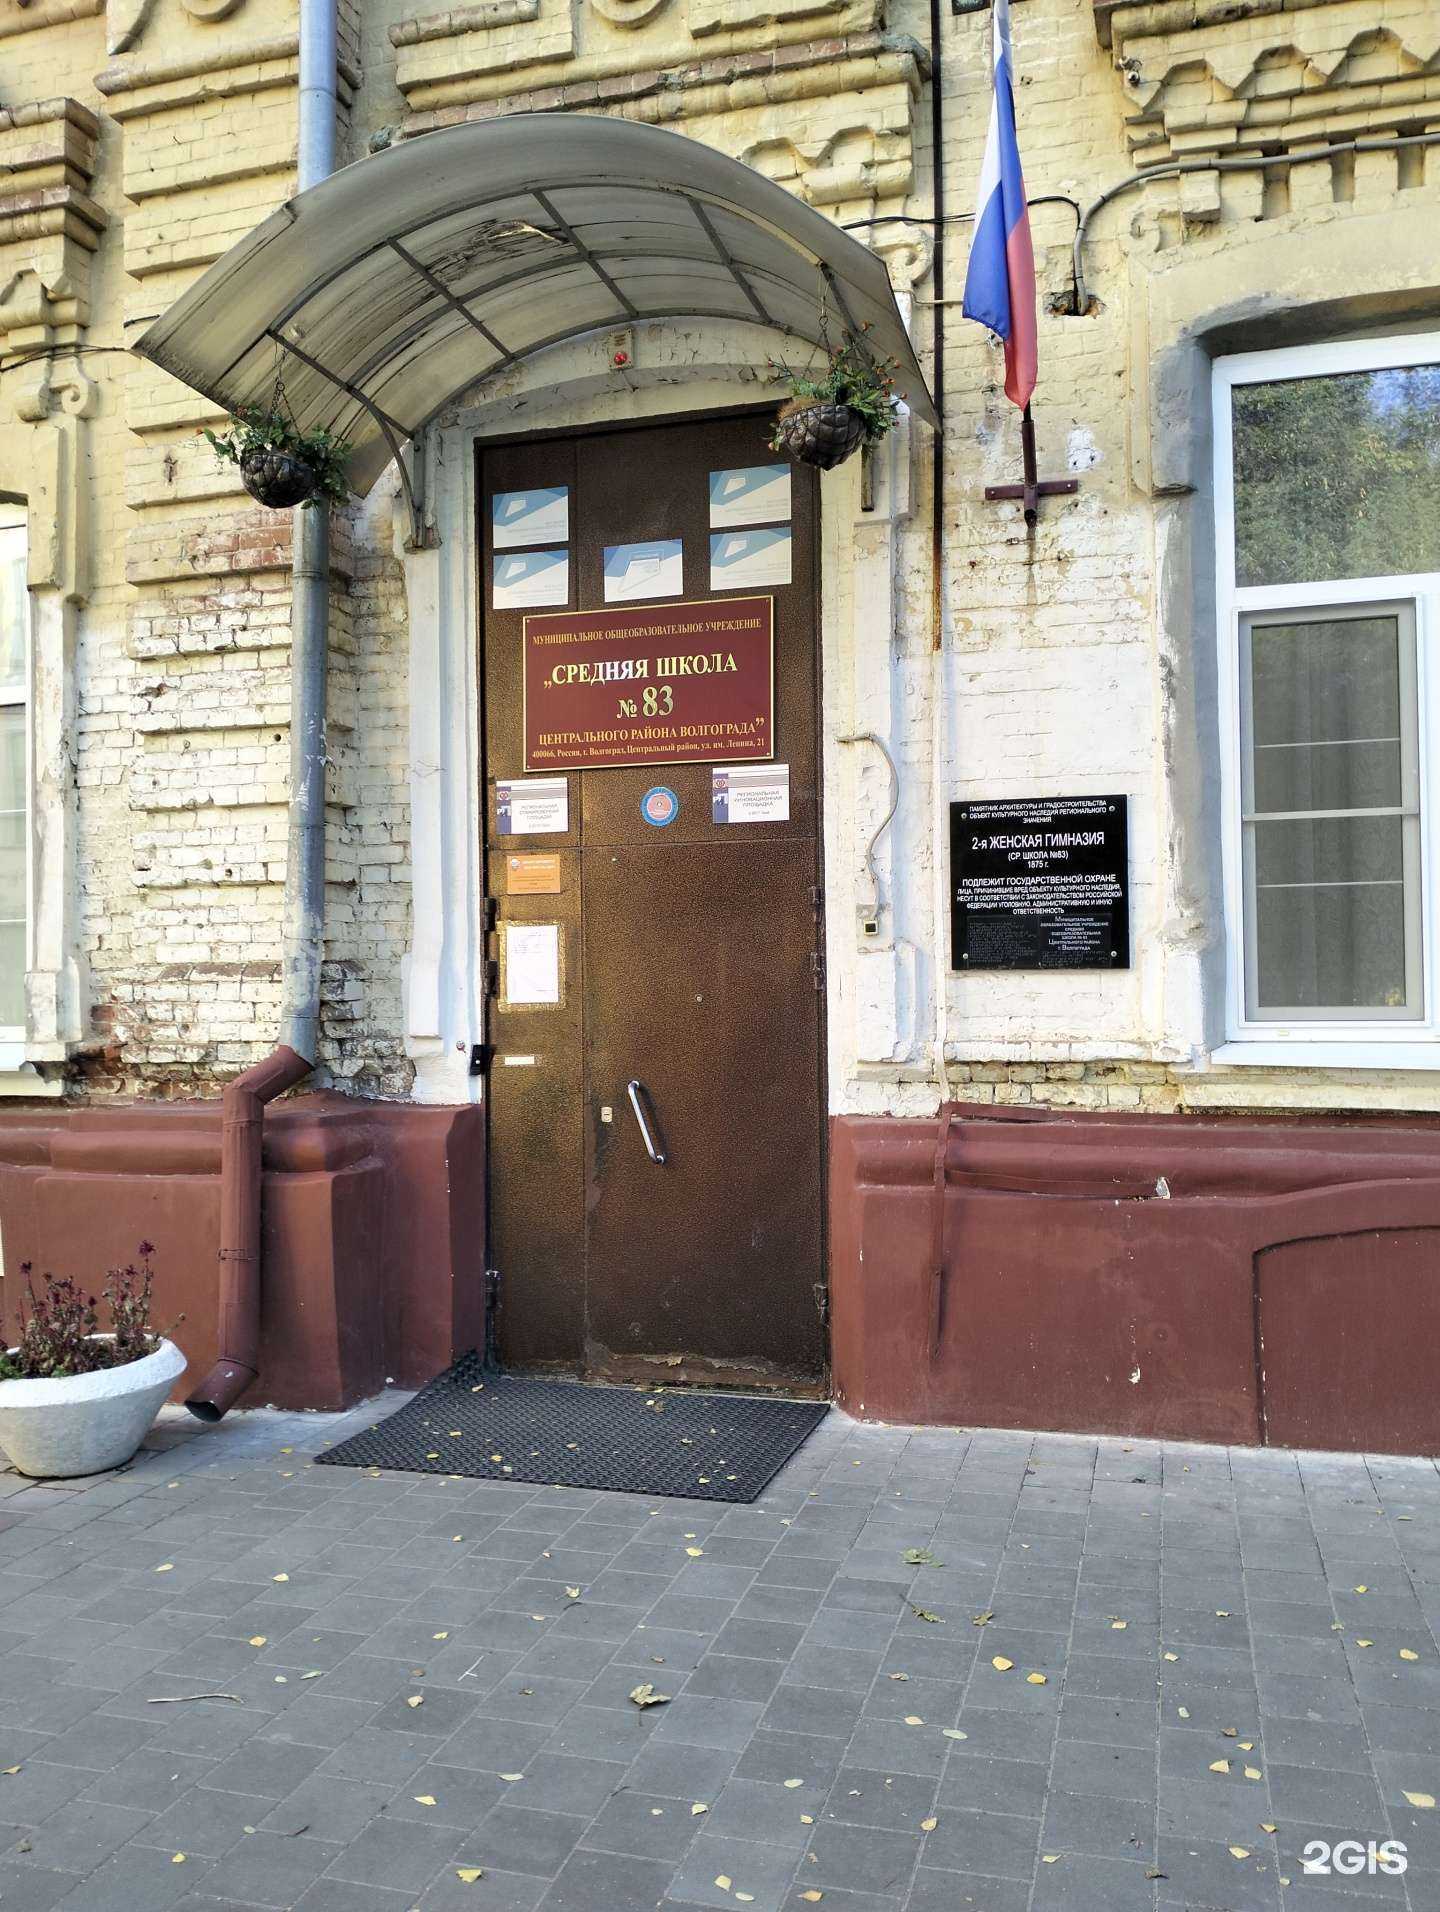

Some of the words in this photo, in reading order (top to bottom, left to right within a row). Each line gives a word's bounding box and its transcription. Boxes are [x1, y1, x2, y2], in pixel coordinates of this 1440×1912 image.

[532, 631, 604, 645] МУНИЦИПАЛЬНОЕ
[605, 623, 704, 640] ОБЩЕОБРАЗОВАТЕЛЬНОЕ
[705, 618, 762, 632] УЧРЕЖДЕНИЕ
[656, 653, 738, 677] ШКОЛА
[616, 699, 637, 719] №
[642, 685, 674, 717] 83
[539, 730, 628, 747] ЦЕНТРАЛЬНОГО
[631, 726, 677, 741] РАЙОНА
[557, 748, 582, 758] Россия,
[627, 743, 675, 755] Центральный
[701, 742, 711, 751] ул.
[756, 738, 765, 747] 21
[969, 803, 998, 812] ПАМЯТНИК
[999, 803, 1037, 811] АРХИТЕКТУРЫ
[1043, 800, 1107, 809] ГРАДОСТРОИТЕЛЬСТВА
[1029, 809, 1058, 817] НАСЛЕДИЯ
[1059, 807, 1107, 815] РЕГИОНАЛЬНОГО
[971, 837, 988, 850] 2-я
[989, 834, 1042, 849] ЖЕНСКАЯ
[1045, 831, 1104, 847] ГИМНАЗИЯ
[1022, 851, 1048, 860] ШКОЛА
[1027, 861, 1043, 869] 1875
[962, 878, 1006, 887] ПОДЛЕЖИТ
[1007, 874, 1083, 886] ГОСУДАРСТВЕННОЙ
[1084, 874, 1117, 883] ОХРАНЕ
[1026, 892, 1084, 900] ЗАКОНОДАТЕЛЬСТВОМ
[1085, 890, 1123, 898] РОССИЙСКОЙ
[1029, 885, 1052, 893] ОБЪЕКТУ
[1032, 899, 1090, 907] АДМИНИСТРАТИВНУЮ
